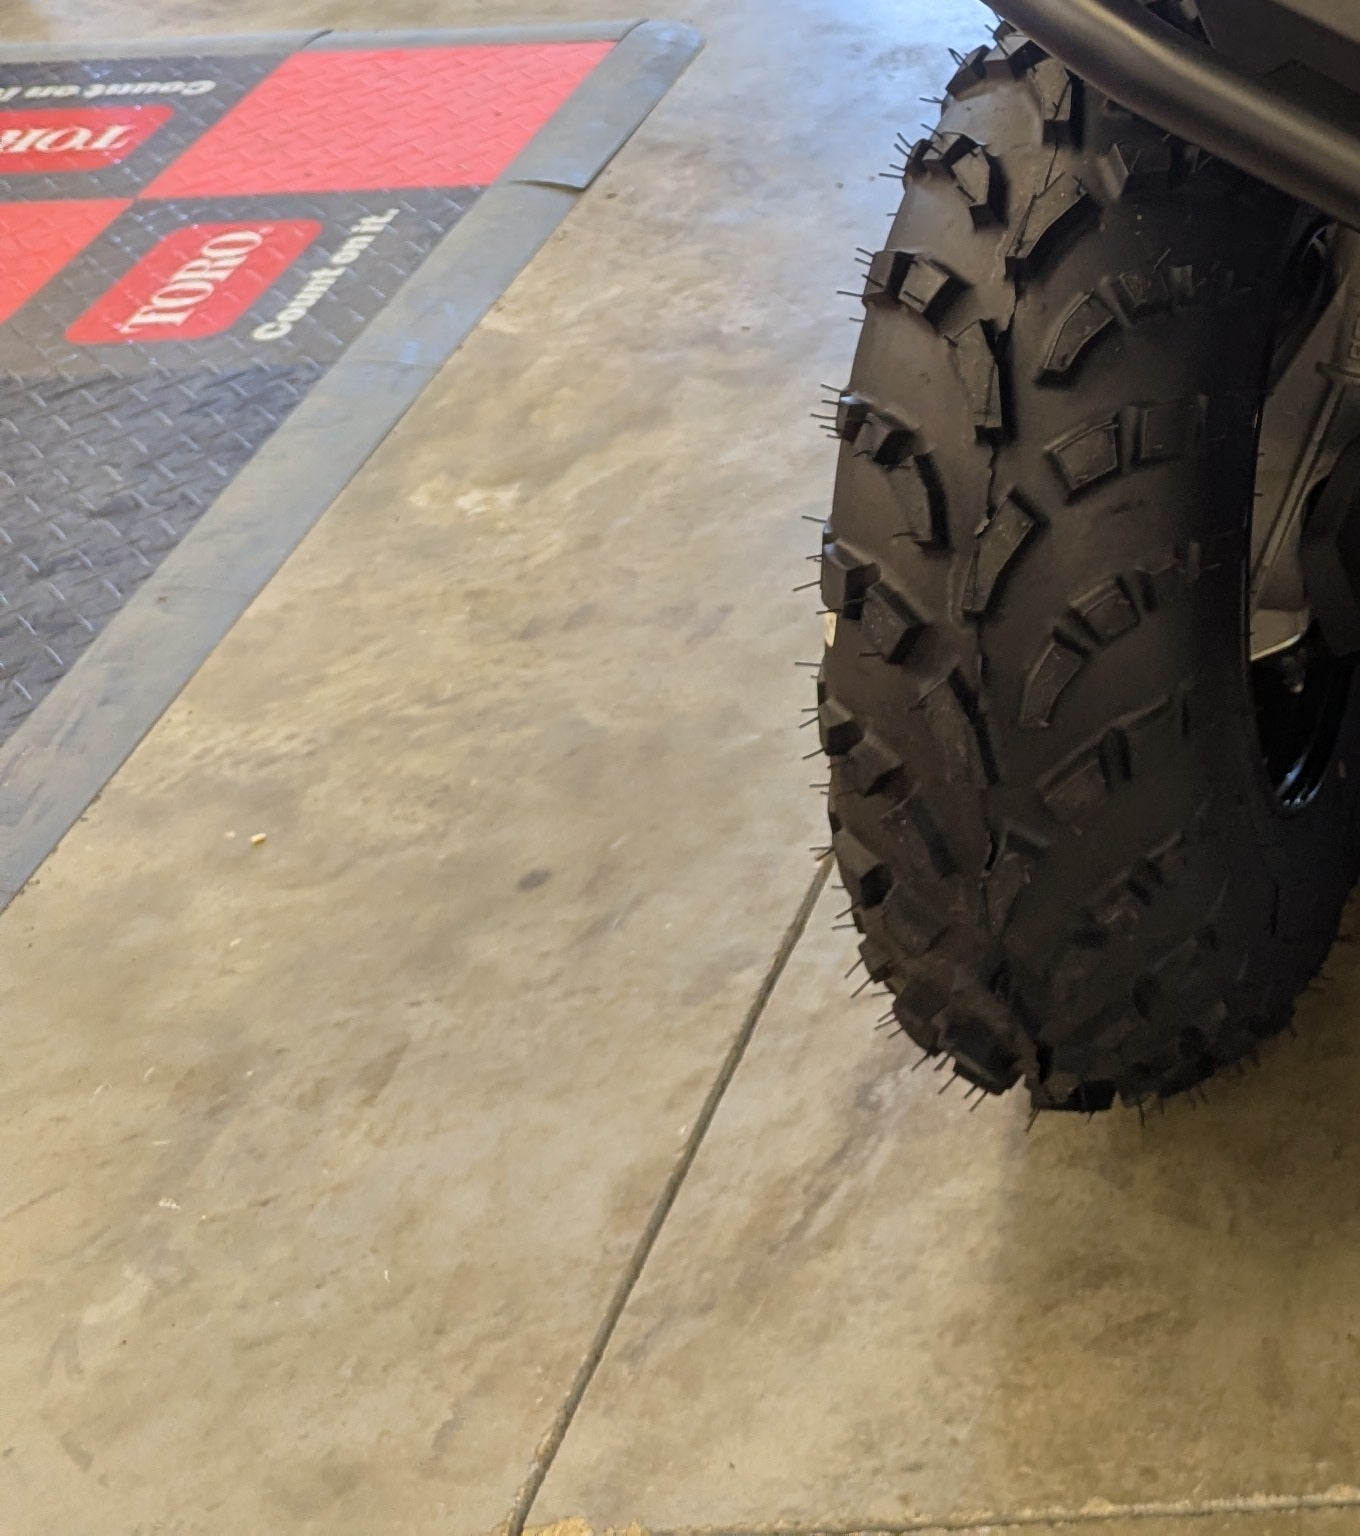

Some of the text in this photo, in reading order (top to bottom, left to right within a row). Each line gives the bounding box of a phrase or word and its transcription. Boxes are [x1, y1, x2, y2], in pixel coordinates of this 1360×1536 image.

[83, 79, 217, 99] Count
[119, 230, 264, 335] TORO
[252, 207, 401, 341] Count on it.
